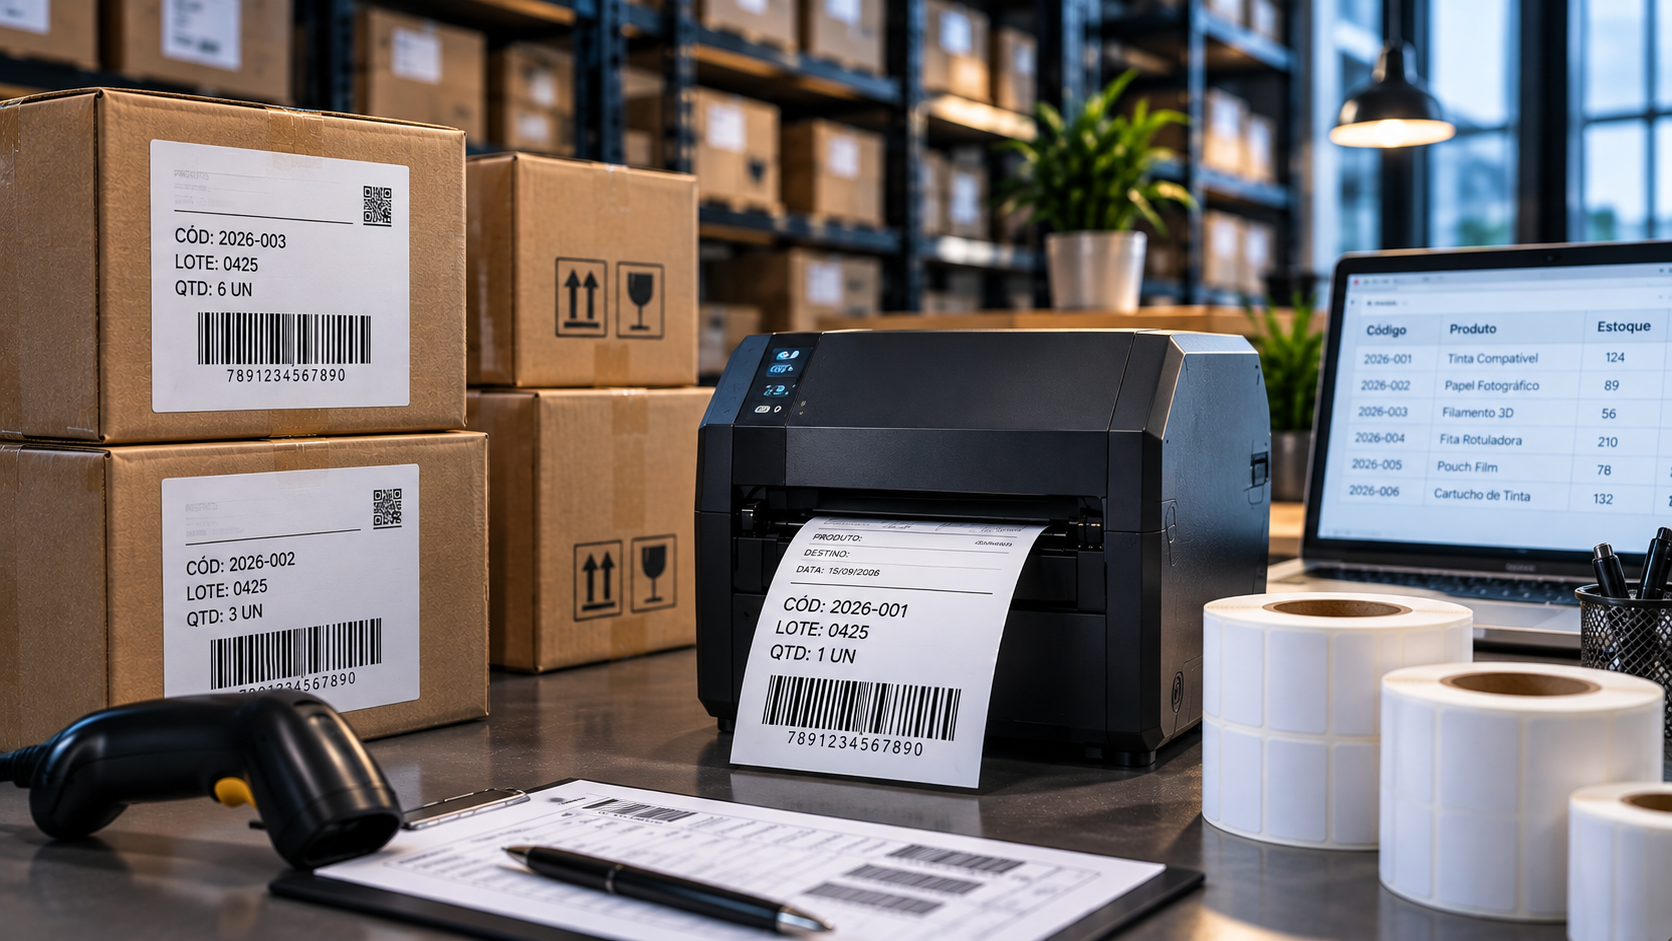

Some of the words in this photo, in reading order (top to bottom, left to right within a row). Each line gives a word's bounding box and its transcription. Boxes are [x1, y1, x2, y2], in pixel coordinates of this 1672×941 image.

[175, 225, 213, 244] CÓD:
[219, 231, 286, 248] 2026-003
[176, 254, 218, 270] LOTE:
[224, 256, 258, 272] 0425
[176, 280, 212, 296] QTD:
[218, 282, 226, 296] 6
[231, 282, 251, 296] UN
[1367, 325, 1406, 338] Código
[1450, 324, 1496, 334] Produto
[1598, 321, 1651, 334] Estoque
[1364, 354, 1411, 364] 2026-001
[1449, 354, 1474, 363] Tinta
[1607, 352, 1624, 362] 124
[227, 369, 345, 382] 7891234567890
[1361, 380, 1410, 391] 2026-002
[1445, 380, 1474, 392] Papel
[1478, 380, 1539, 393] Fotográfico
[1605, 380, 1619, 391] 89
[1358, 406, 1408, 417] 2026-003
[1443, 407, 1495, 418] Filamento
[1499, 408, 1514, 418] 3D
[1602, 408, 1616, 419] 56
[1355, 432, 1404, 443] 2026-004
[1440, 434, 1459, 444] Fita
[1463, 435, 1522, 445] Rotuladora
[1598, 437, 1618, 447] 210
[1352, 459, 1402, 470] 2026-005
[1438, 461, 1471, 472] Pouch
[1475, 462, 1498, 472] Film
[1598, 465, 1611, 475] 78
[1350, 485, 1399, 496] 2026-006
[1434, 488, 1483, 500] Cartucho
[1487, 490, 1500, 500] de
[1504, 490, 1530, 501] Tinta
[1594, 494, 1613, 504] 132
[804, 549, 849, 557] DESTINO:
[187, 556, 223, 575] CÓD:
[230, 552, 295, 571] 2026-002
[187, 583, 228, 601] LOTE:
[234, 579, 267, 595] 0425
[784, 595, 825, 612] CÓD:
[830, 600, 907, 617] 2026-001
[187, 610, 223, 627] QTD:
[229, 607, 237, 621] 3
[242, 604, 262, 619] UN
[776, 620, 823, 636] LOTE:
[829, 623, 869, 639] 0425
[771, 644, 811, 660] QTD:
[816, 647, 824, 661] 1
[831, 648, 856, 663] UN
[787, 731, 923, 756] 7891234567890
